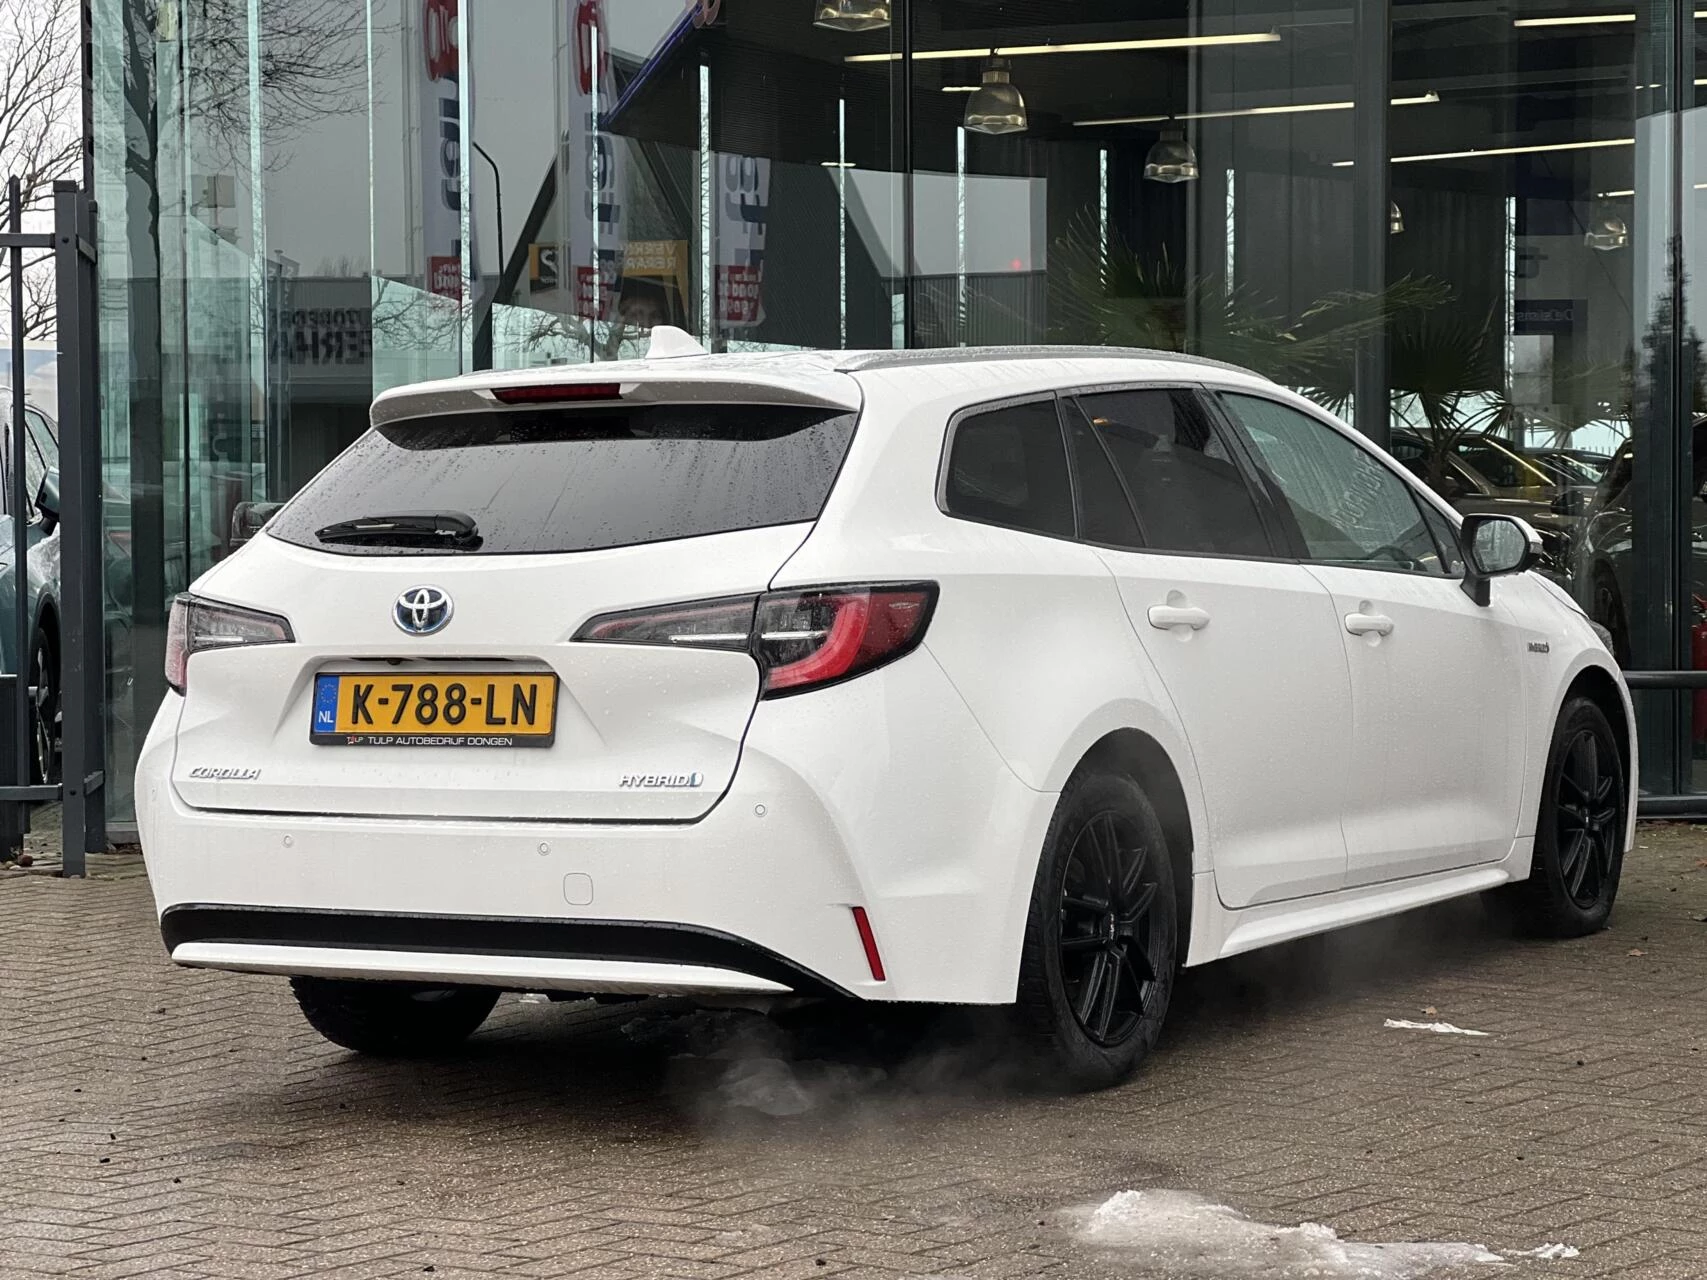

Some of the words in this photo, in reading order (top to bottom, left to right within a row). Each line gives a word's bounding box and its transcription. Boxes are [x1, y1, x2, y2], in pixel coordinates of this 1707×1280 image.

[351, 682, 538, 726] K-788-LN
[319, 711, 334, 724] NL
[368, 736, 393, 745] TULP
[396, 736, 465, 746] AUTOBEDRIJF
[467, 737, 513, 747] DONGEN
[189, 766, 263, 781] COROLLA
[618, 773, 692, 789] HYBRID
